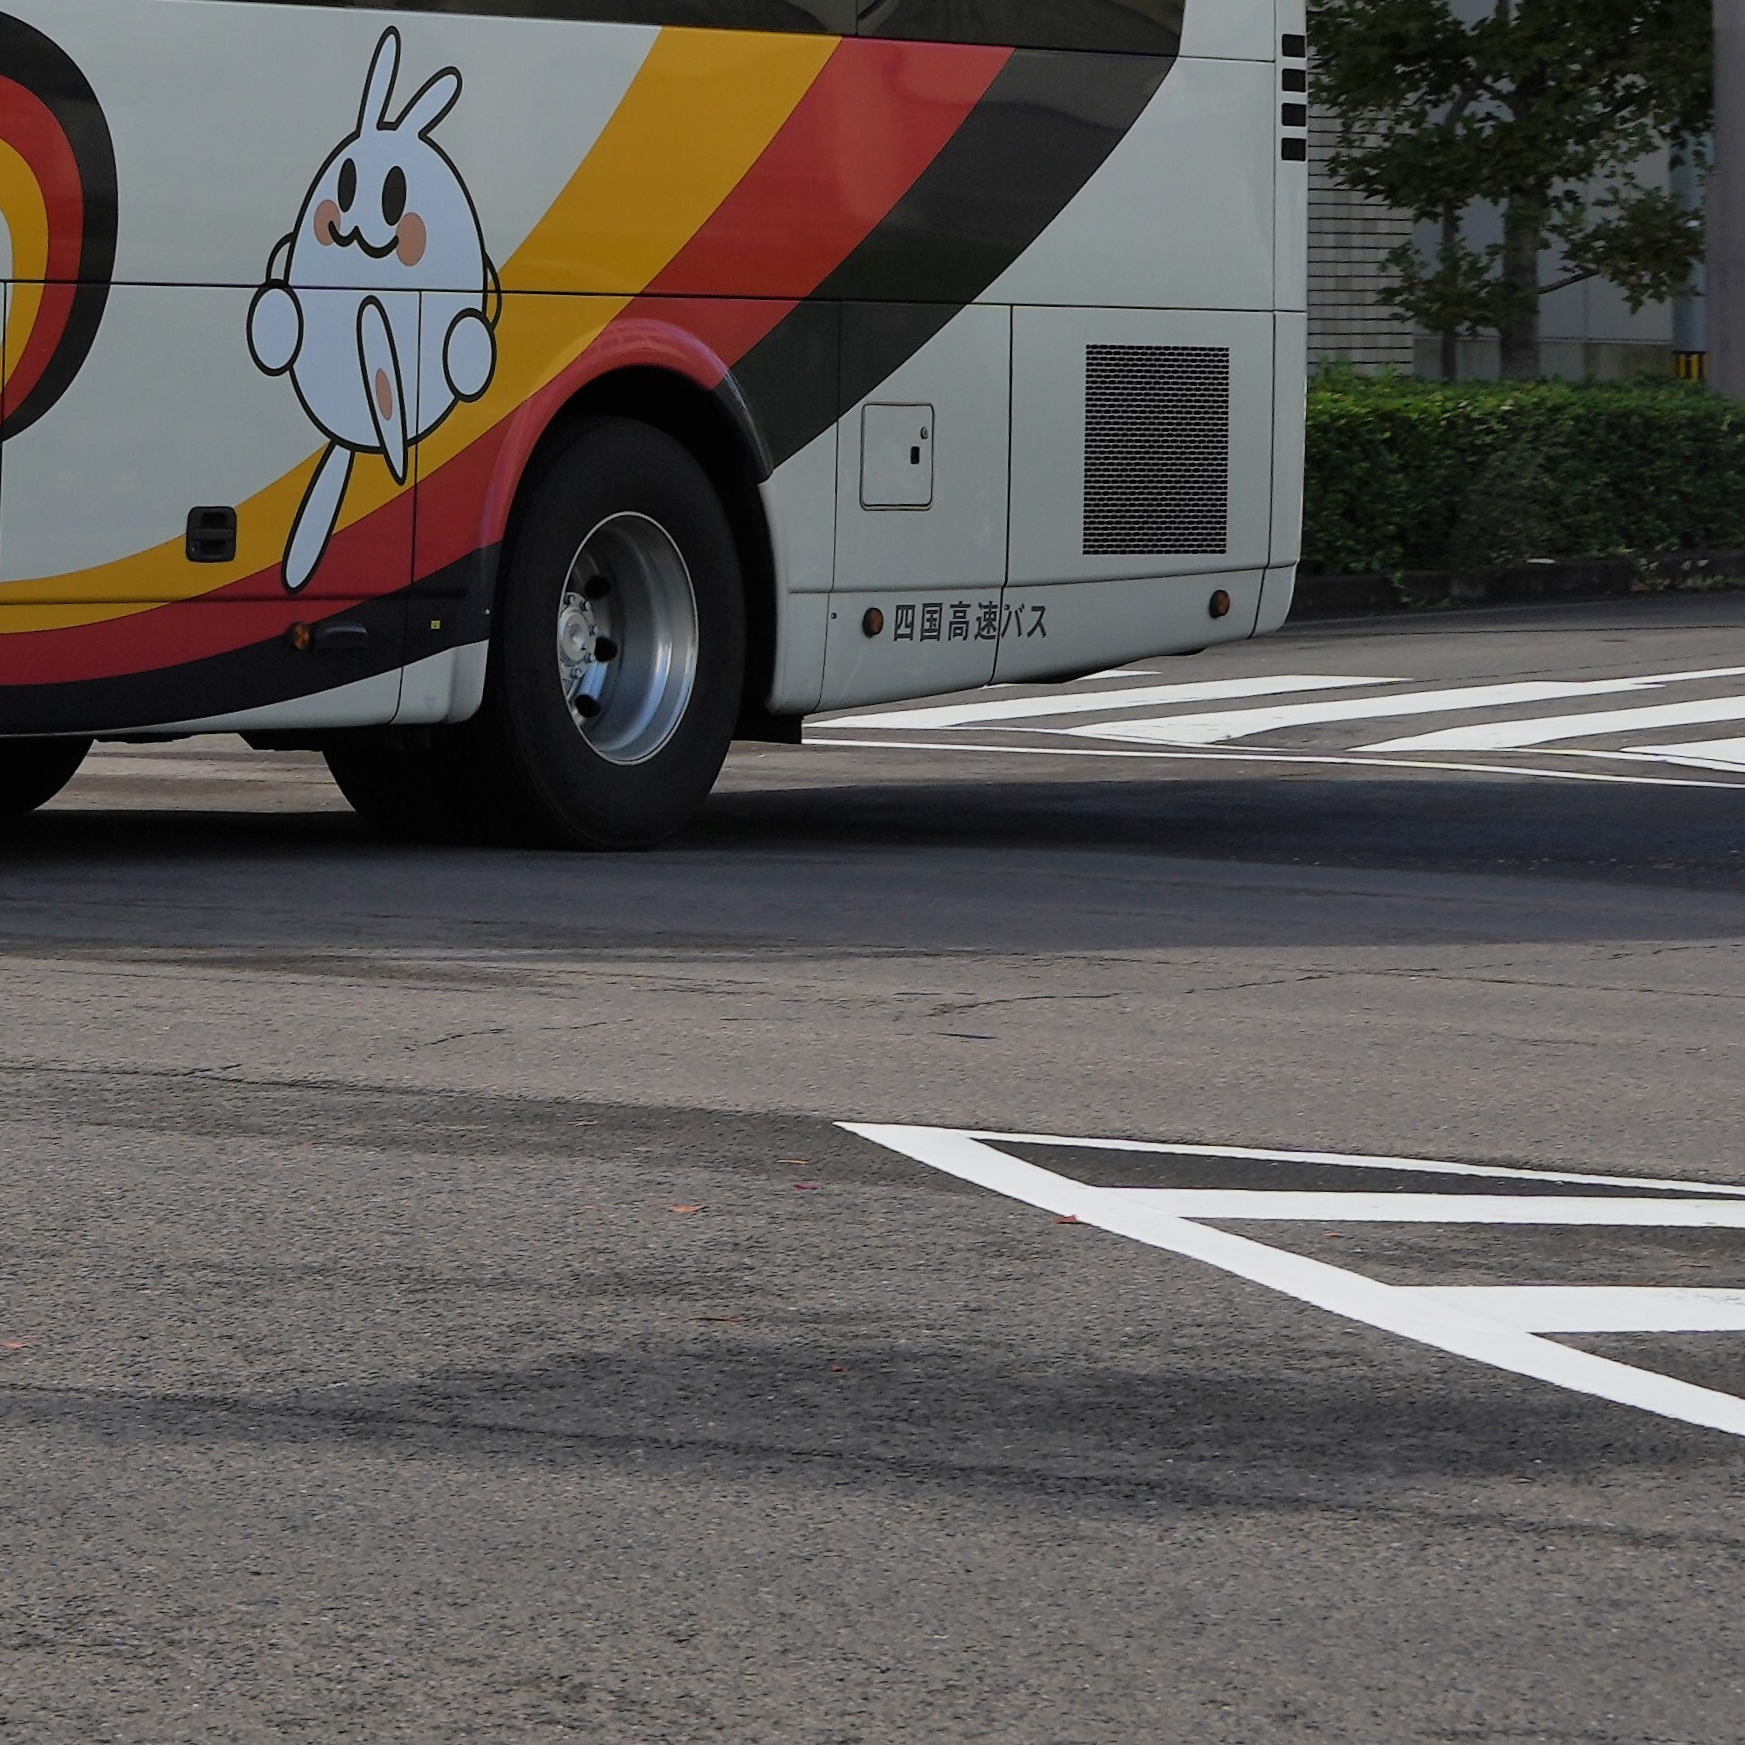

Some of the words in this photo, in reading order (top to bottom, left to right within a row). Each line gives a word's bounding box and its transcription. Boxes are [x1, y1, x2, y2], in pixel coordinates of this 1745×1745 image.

[893, 600, 1047, 642] 四国高速バス
